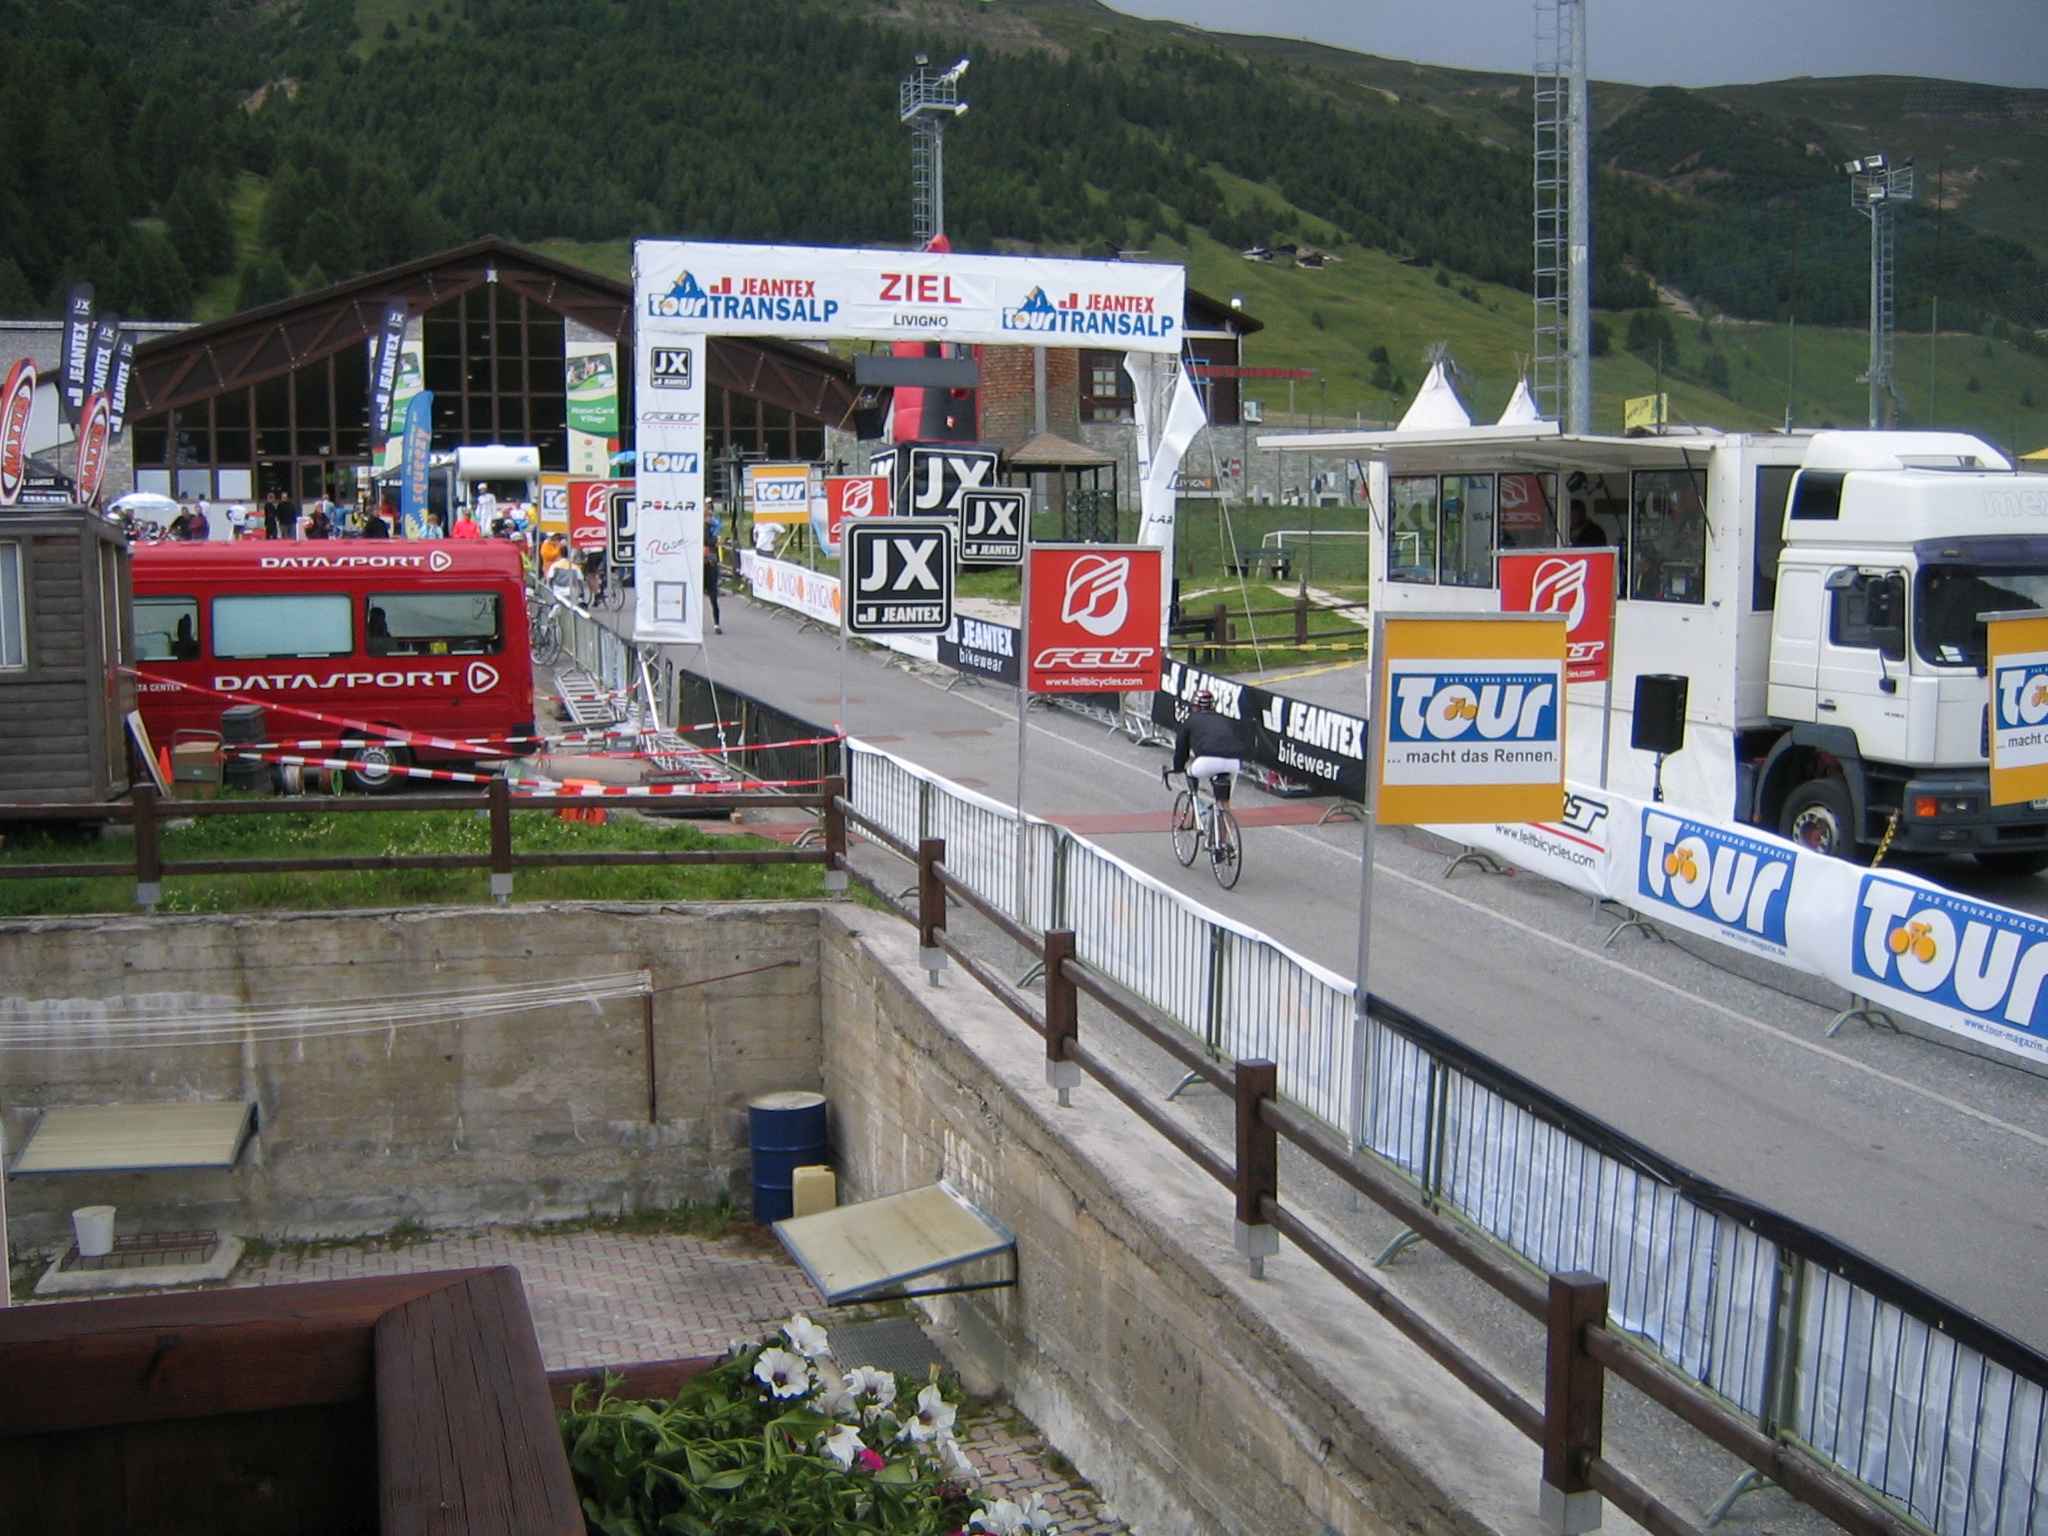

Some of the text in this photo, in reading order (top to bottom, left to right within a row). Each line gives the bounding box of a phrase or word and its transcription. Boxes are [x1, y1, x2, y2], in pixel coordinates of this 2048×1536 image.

[739, 278, 816, 298] JEANTEX
[880, 273, 962, 304] ZIEL
[707, 296, 839, 323] TRANSALP
[1085, 294, 1155, 314] JEANTEX
[893, 313, 949, 328] LIVIGNO
[1058, 310, 1174, 337] TRANSALP
[69, 322, 89, 384] JEANTEX
[379, 333, 401, 393] JEANTEX
[655, 352, 688, 374] JX
[113, 362, 130, 413] JEANTEX
[3, 396, 31, 478] MAXXIS
[916, 456, 991, 509] JX
[641, 501, 697, 511] POLAR
[967, 501, 1018, 536] JX
[260, 556, 425, 568] DATASPORT
[979, 543, 1018, 556] JEANTEX
[860, 539, 940, 592] JX
[882, 606, 941, 624] JEANTEX
[962, 618, 1014, 658] JEANTEX
[959, 648, 1003, 673] bikewear
[1033, 647, 1154, 669] FELT
[214, 671, 460, 692] DATASPORT
[1045, 675, 1143, 688] www.feltbicycles.com
[1286, 702, 1366, 760] JEANTEX
[2008, 733, 2042, 748] macht
[1278, 739, 1340, 781] bikewear
[1406, 749, 1456, 764] macht
[1461, 749, 1489, 764] das
[1494, 748, 1558, 763] Rennen.
[1683, 823, 1701, 834] DAS
[1918, 892, 2048, 937] DAS RENNRAD-MAGA
[1964, 1018, 2048, 1053] www.tour-magazin.
